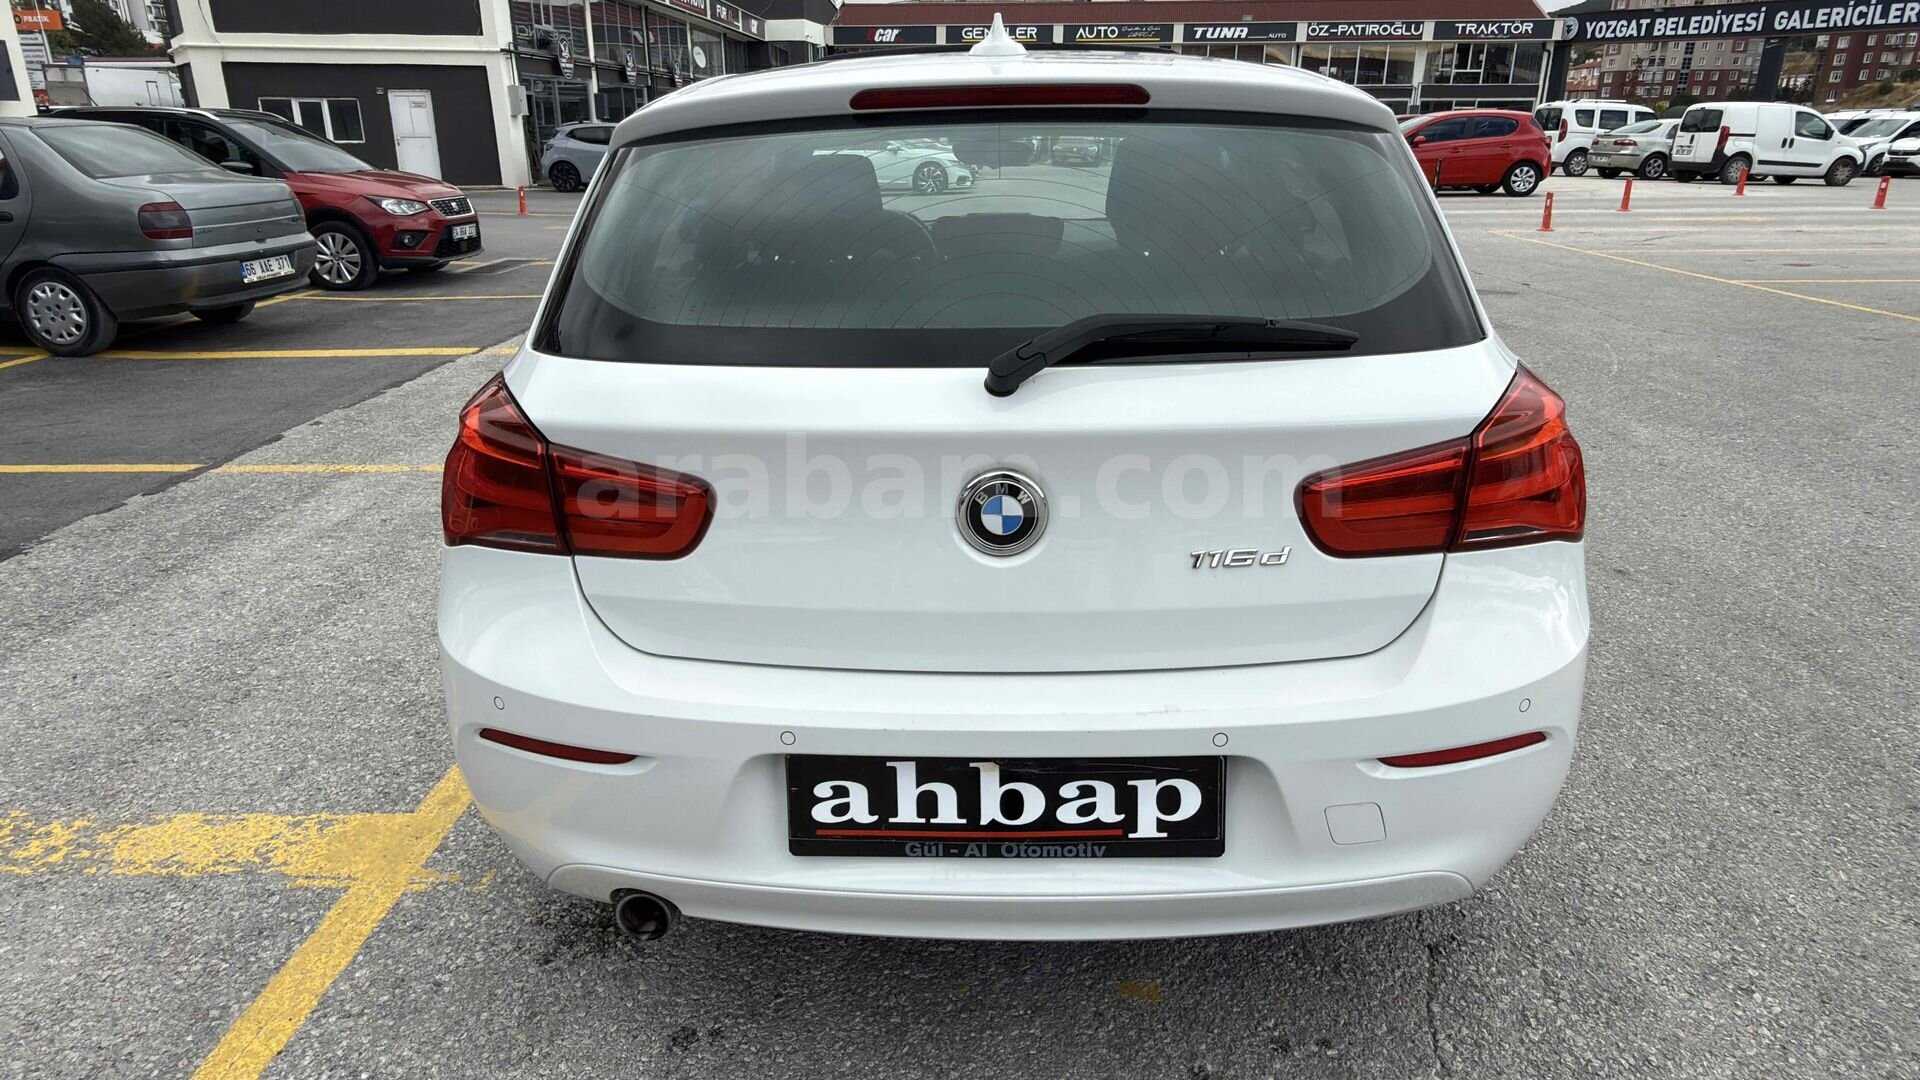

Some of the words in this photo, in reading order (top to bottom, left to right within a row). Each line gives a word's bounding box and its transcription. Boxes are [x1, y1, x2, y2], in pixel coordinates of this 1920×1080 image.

[1455, 20, 1534, 35] TRAKTÖR
[1585, 19, 1651, 39] YOZGAT
[1653, 6, 1767, 36] BELEDİYESİ
[1773, 0, 1920, 31] GALERİCİLER
[961, 26, 1037, 39] GENLER
[1075, 26, 1119, 39] AUTO
[1193, 26, 1248, 39] TUNA
[1308, 22, 1424, 36] ÖZ-PATIROĞLU
[244, 262, 257, 277] 66
[258, 259, 274, 274] AAE
[275, 256, 291, 270] 371
[974, 483, 1032, 506] BMW
[1190, 545, 1292, 569] 116d
[810, 761, 1203, 839] ahbap
[904, 841, 944, 857] Gül
[1000, 842, 1107, 858] Otomotiv
